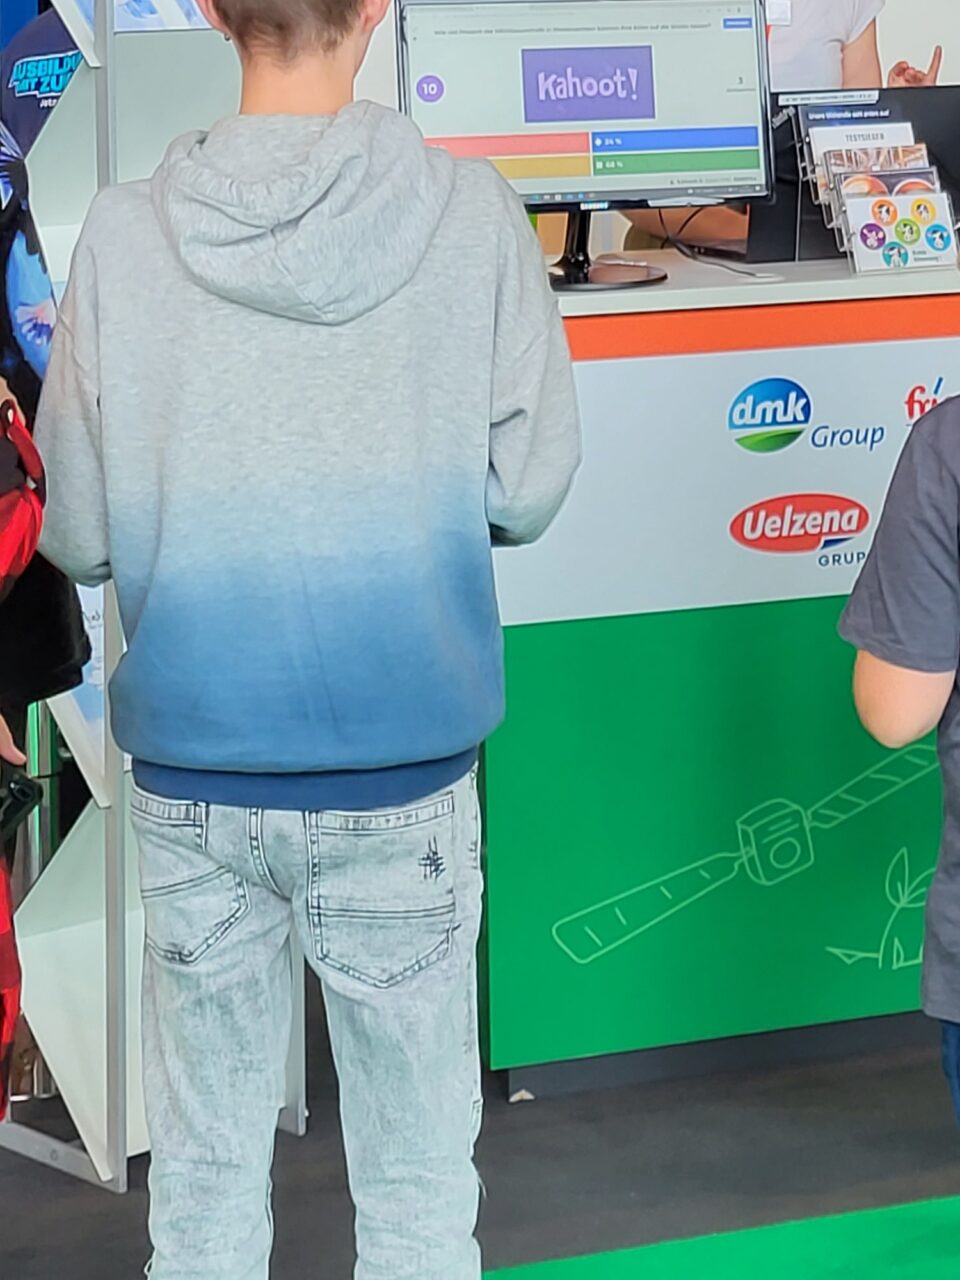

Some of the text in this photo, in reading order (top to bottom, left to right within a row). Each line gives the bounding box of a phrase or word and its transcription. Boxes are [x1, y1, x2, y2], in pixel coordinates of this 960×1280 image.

[422, 83, 437, 95] 10
[537, 67, 639, 101] Kahoot!
[732, 391, 808, 425] dmk
[810, 424, 885, 452] Group
[743, 505, 860, 541] Uelzena
